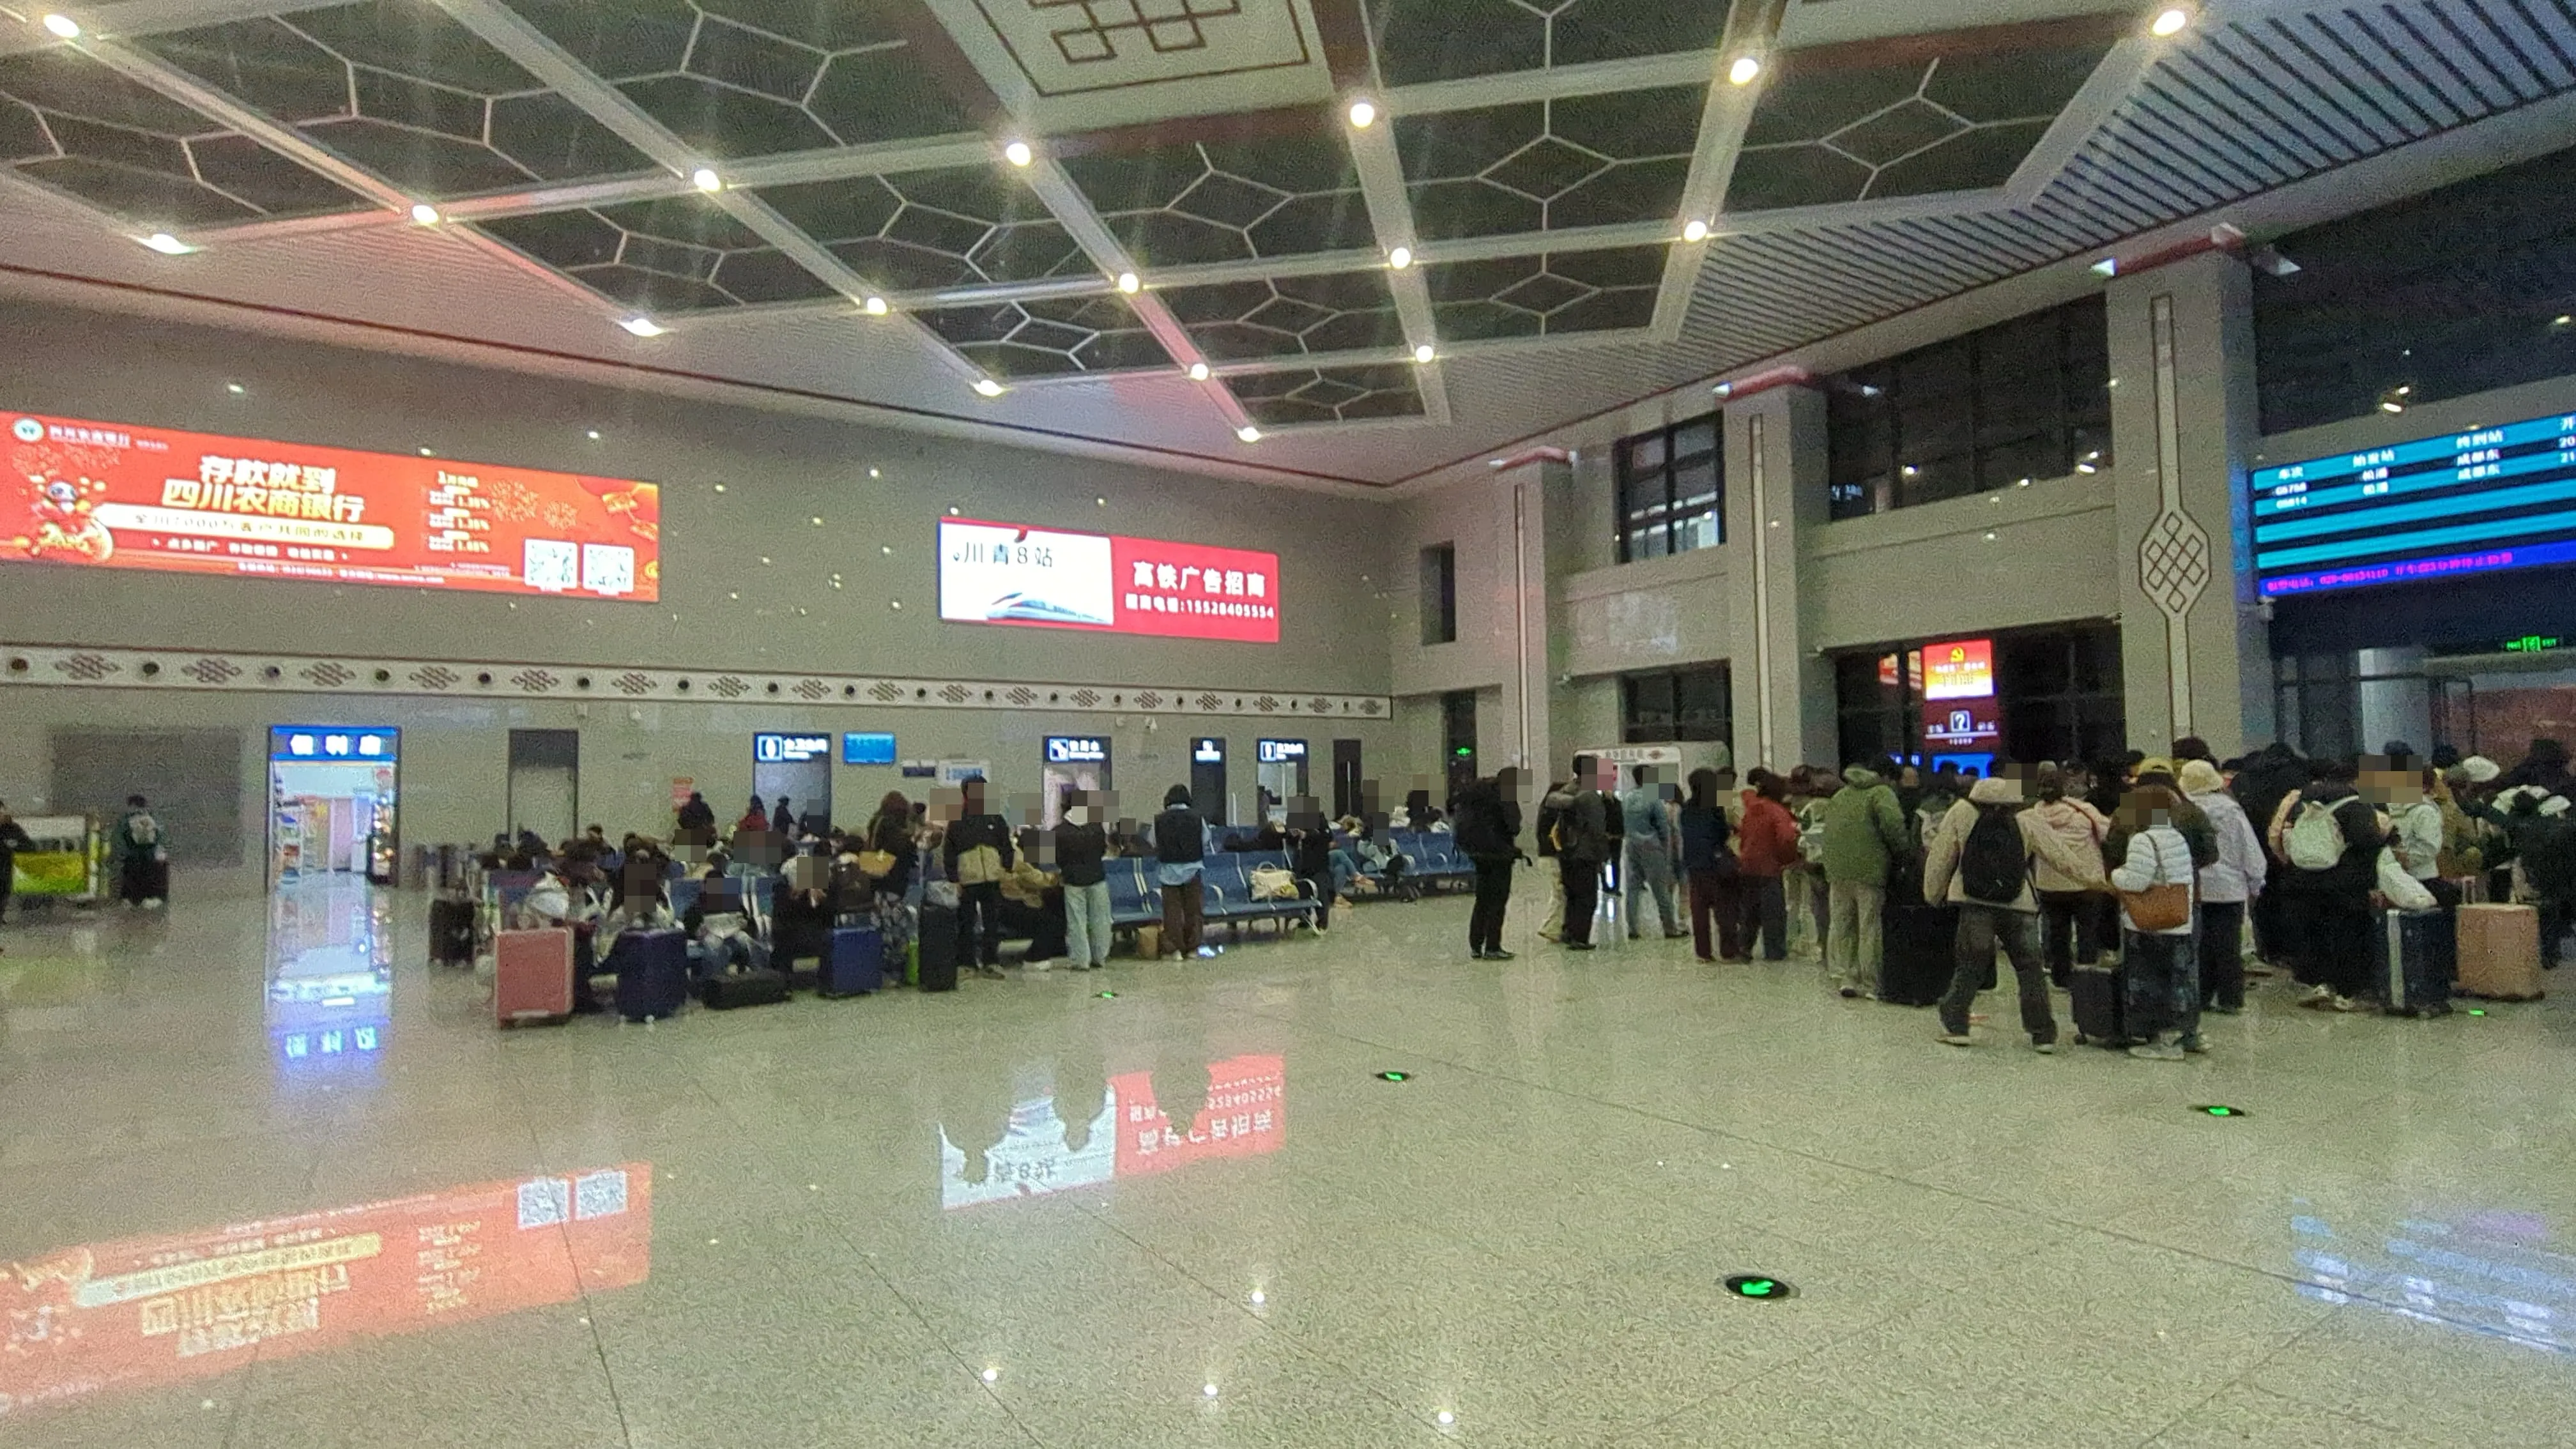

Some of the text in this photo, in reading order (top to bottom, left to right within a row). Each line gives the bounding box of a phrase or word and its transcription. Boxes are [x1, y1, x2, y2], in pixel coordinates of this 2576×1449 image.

[199, 455, 336, 494] 存款就到
[162, 478, 365, 523] 四川农商银行
[1133, 561, 1265, 597] 高铁广告招商
